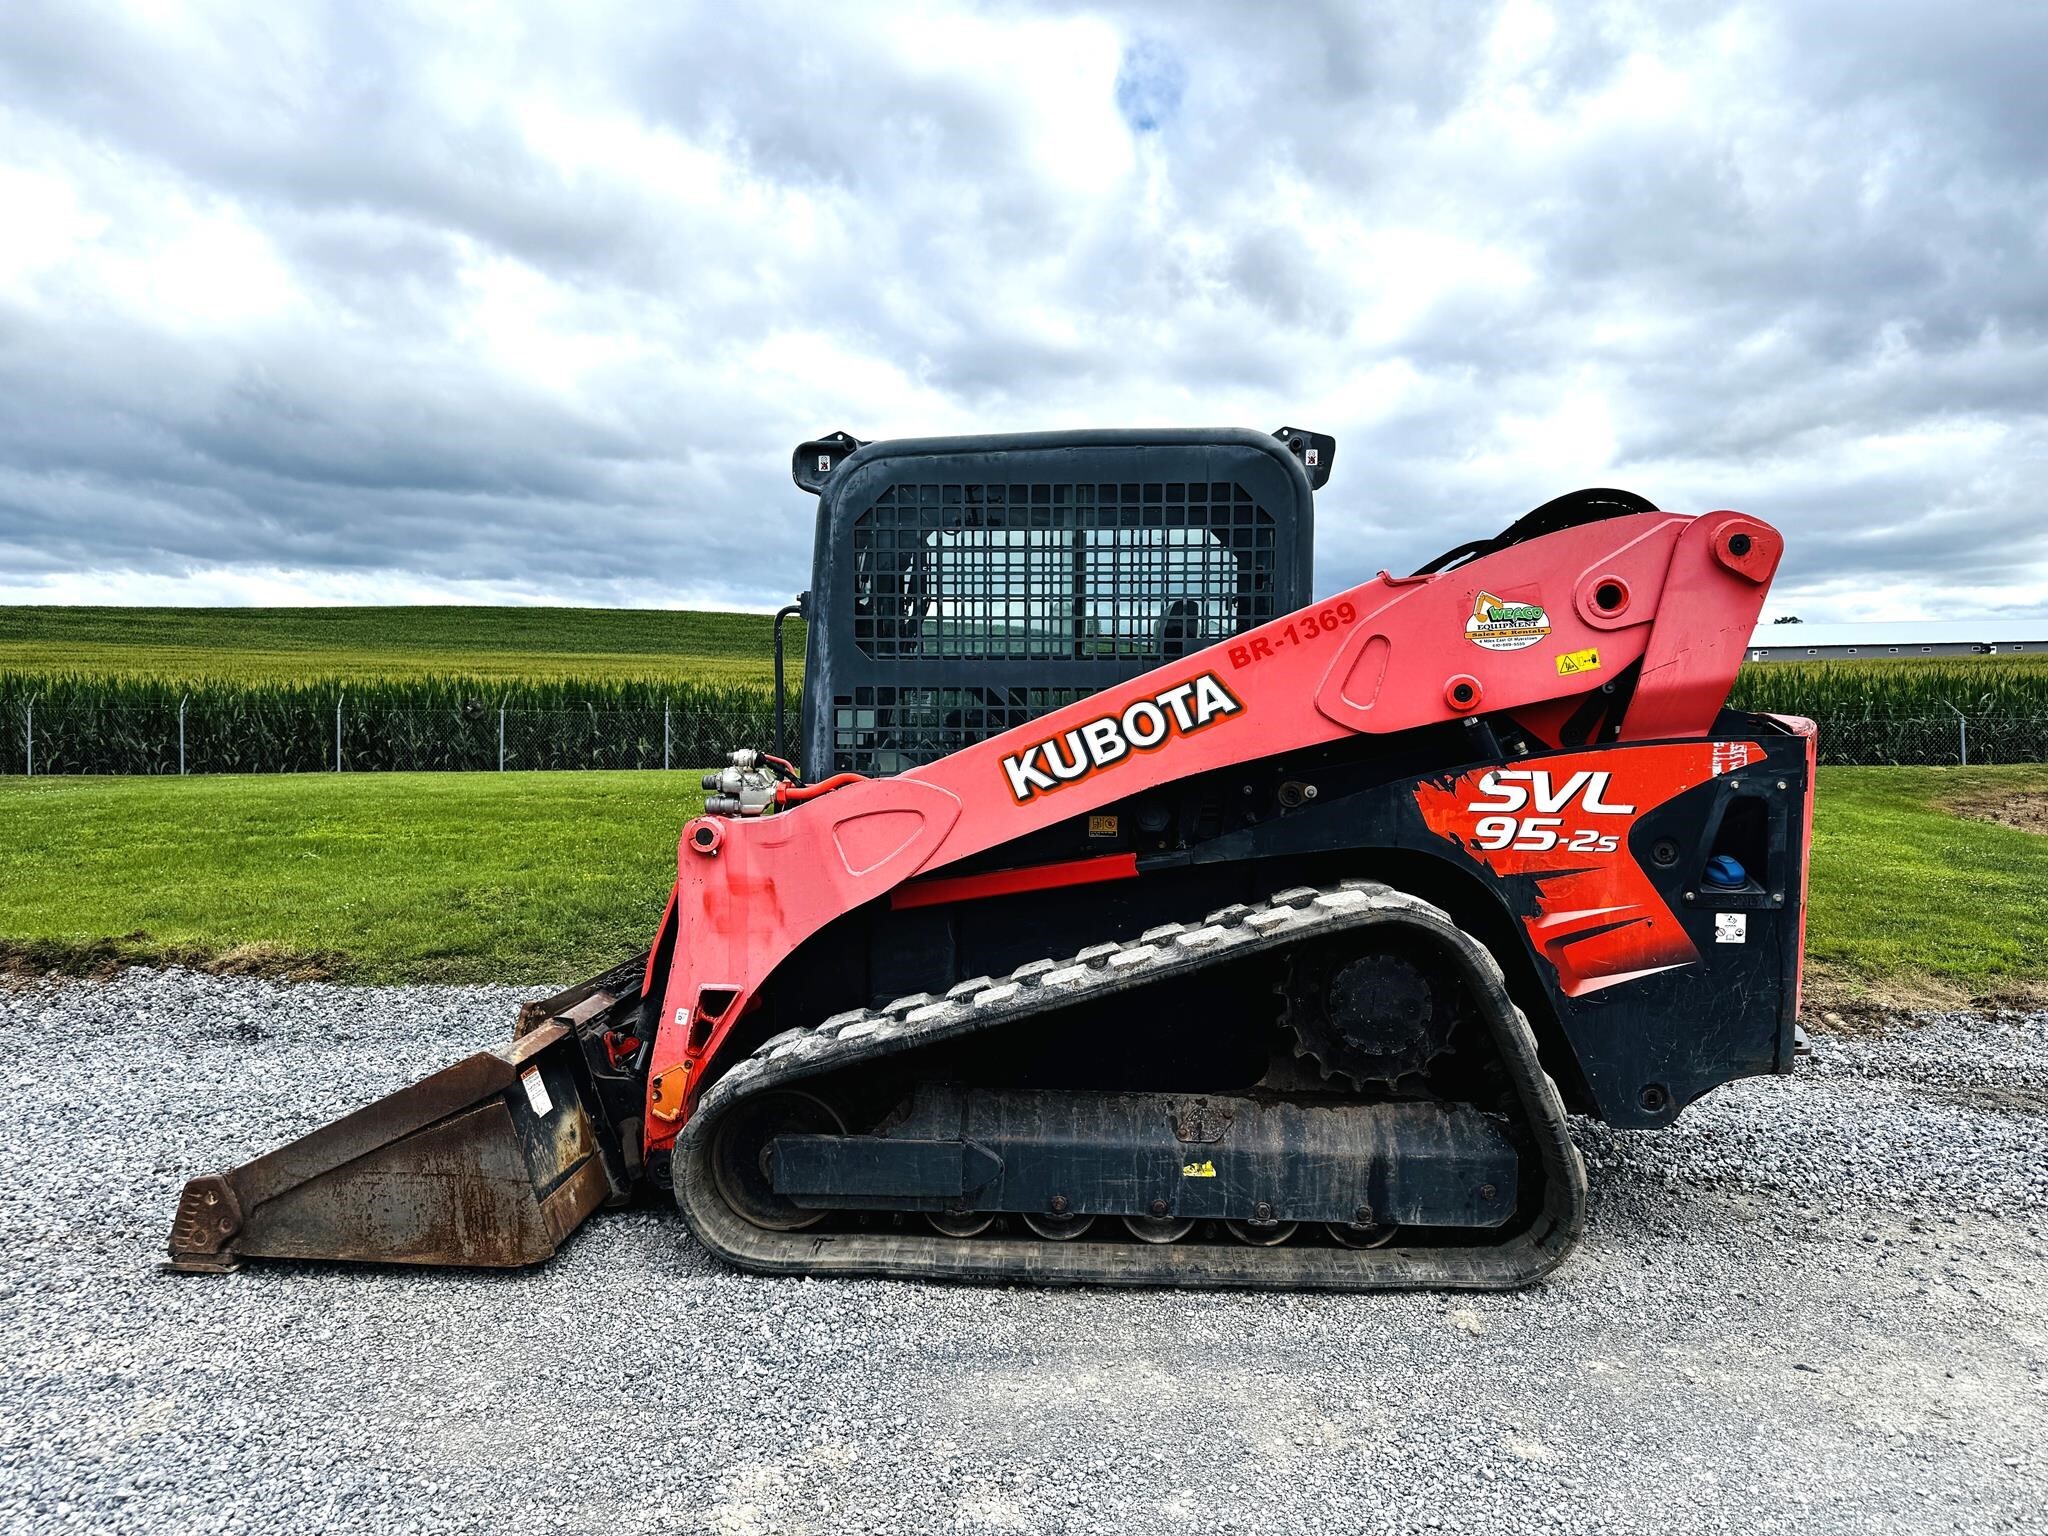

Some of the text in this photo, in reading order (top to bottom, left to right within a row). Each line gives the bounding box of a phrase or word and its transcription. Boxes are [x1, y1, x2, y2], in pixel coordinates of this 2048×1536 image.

[1227, 601, 1358, 671] BR-1369
[1477, 622, 1538, 631] EQUIPMENT
[1487, 606, 1544, 622] WEACO
[1003, 675, 1240, 800] KUBOTA
[1467, 770, 1638, 815] SVL
